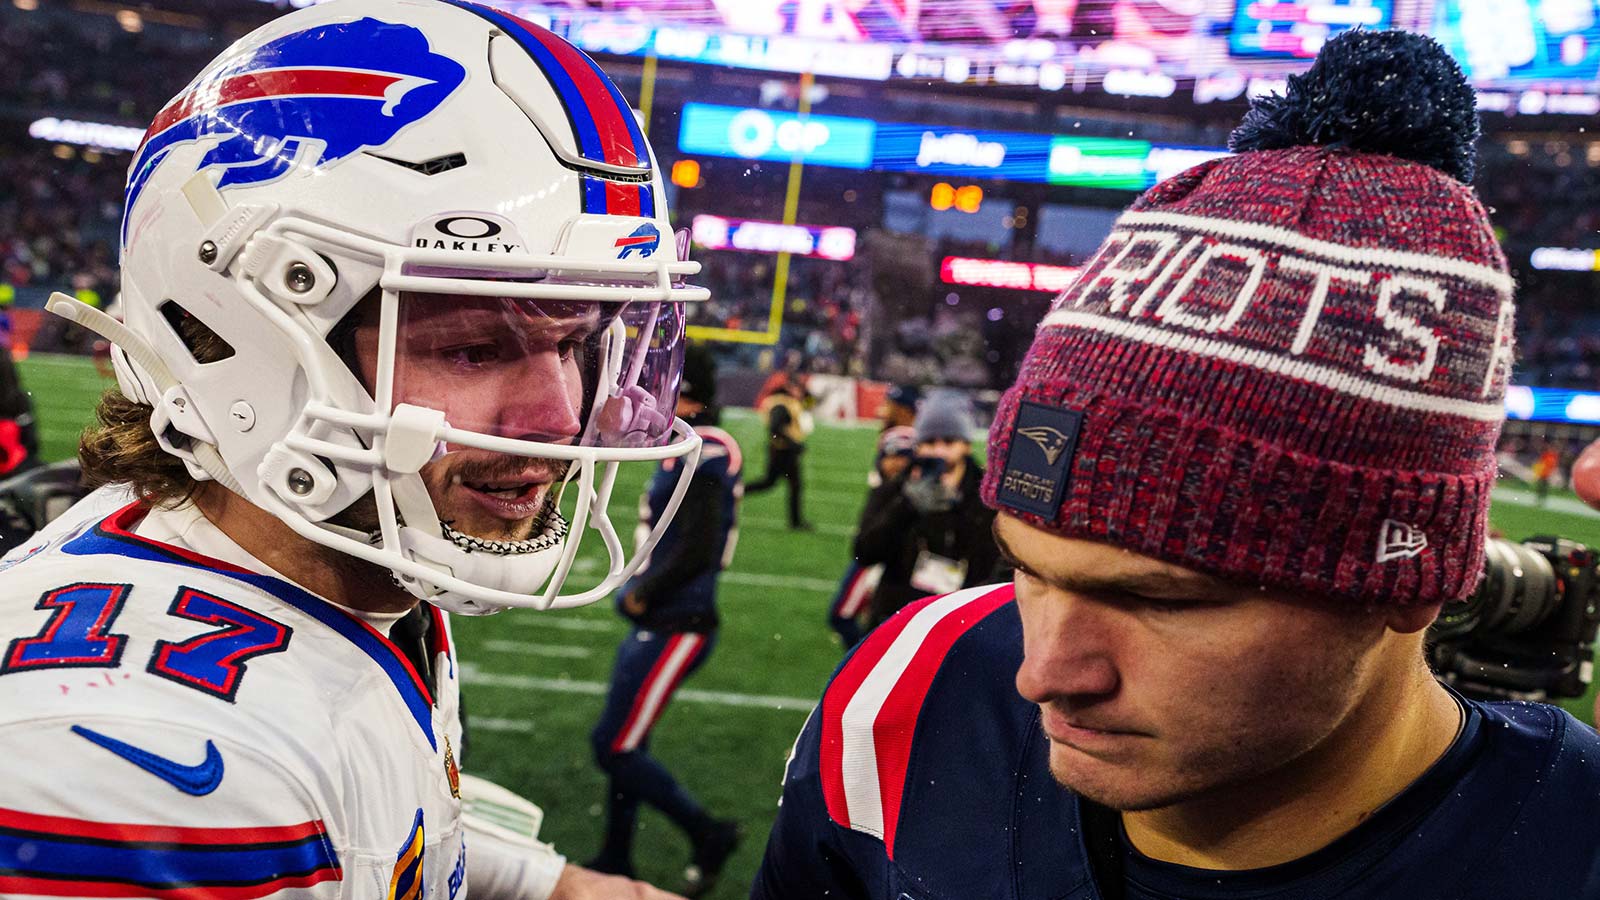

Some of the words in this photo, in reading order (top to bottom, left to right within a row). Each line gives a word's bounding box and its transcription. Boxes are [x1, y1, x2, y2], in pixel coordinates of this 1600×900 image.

[416, 238, 515, 253] OAKLEY
[1004, 476, 1054, 503] PATRIOTS
[1, 582, 294, 704] 17
